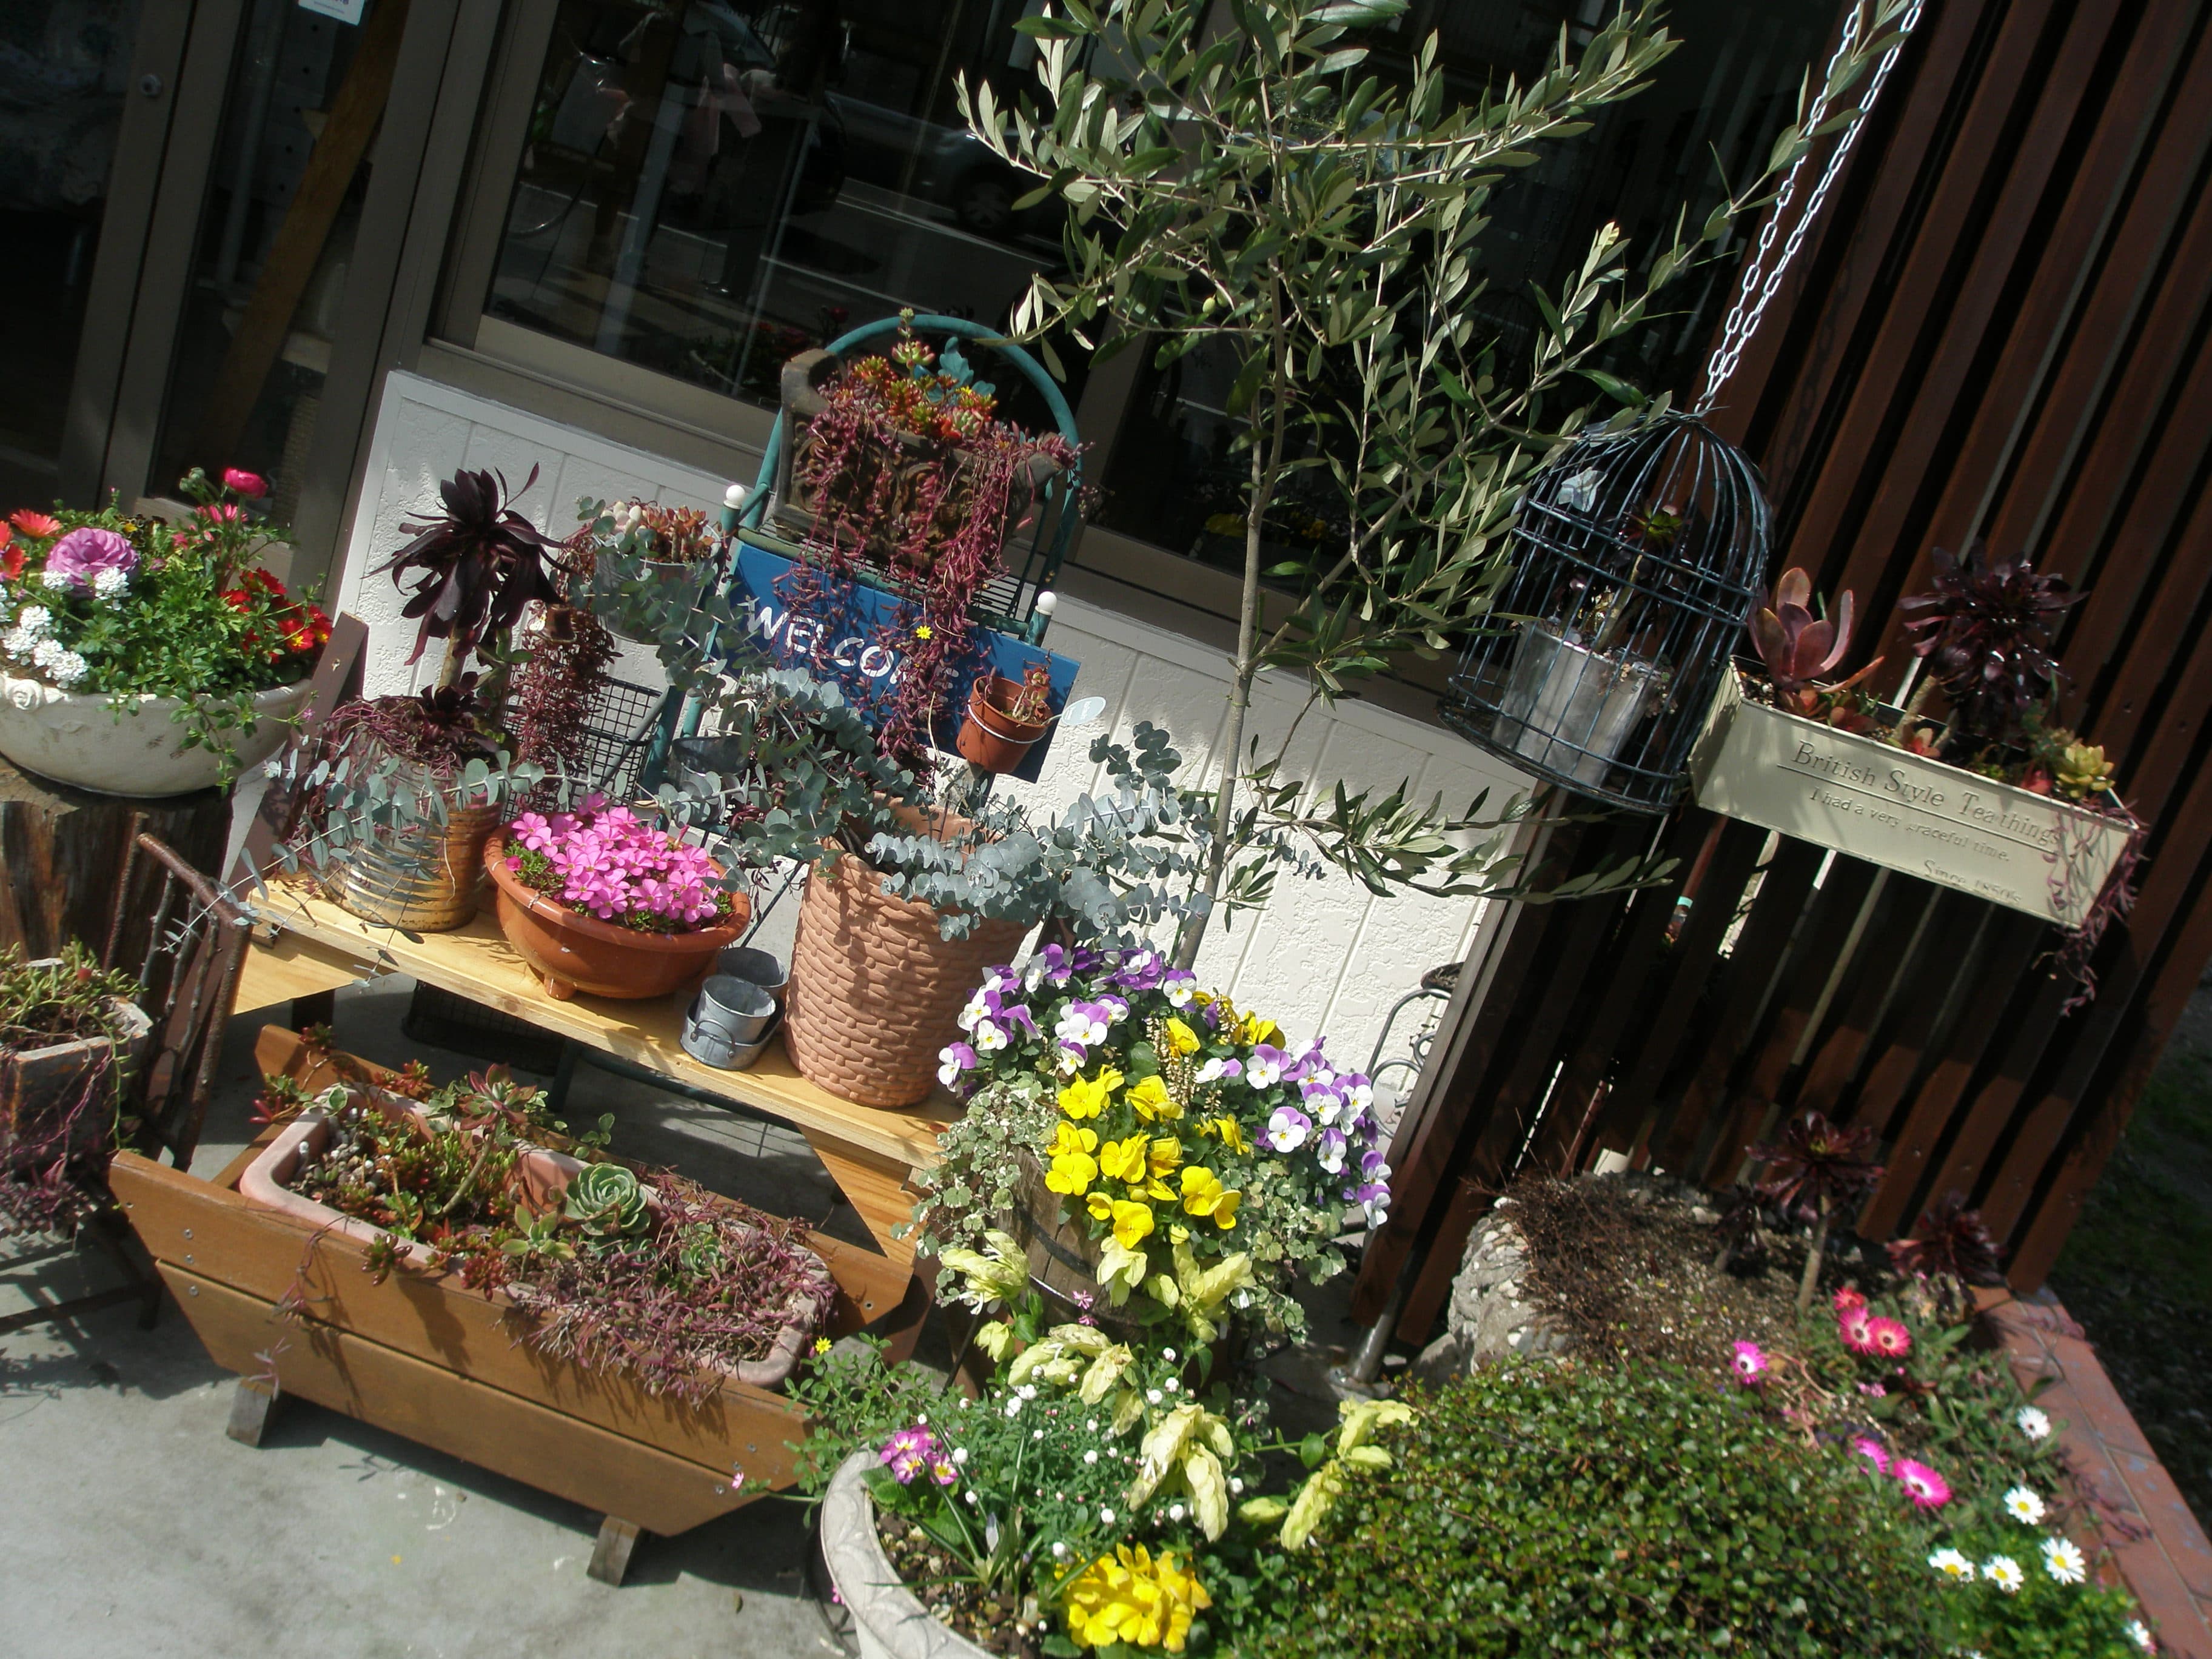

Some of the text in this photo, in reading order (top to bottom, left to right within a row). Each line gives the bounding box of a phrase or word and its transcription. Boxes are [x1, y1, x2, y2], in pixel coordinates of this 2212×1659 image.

[1791, 739, 1876, 786] British
[1884, 768, 1945, 807] Style
[1809, 786, 1820, 801] I
[1821, 791, 1853, 811] had
[1854, 804, 1863, 815] a
[1870, 808, 1902, 828] very
